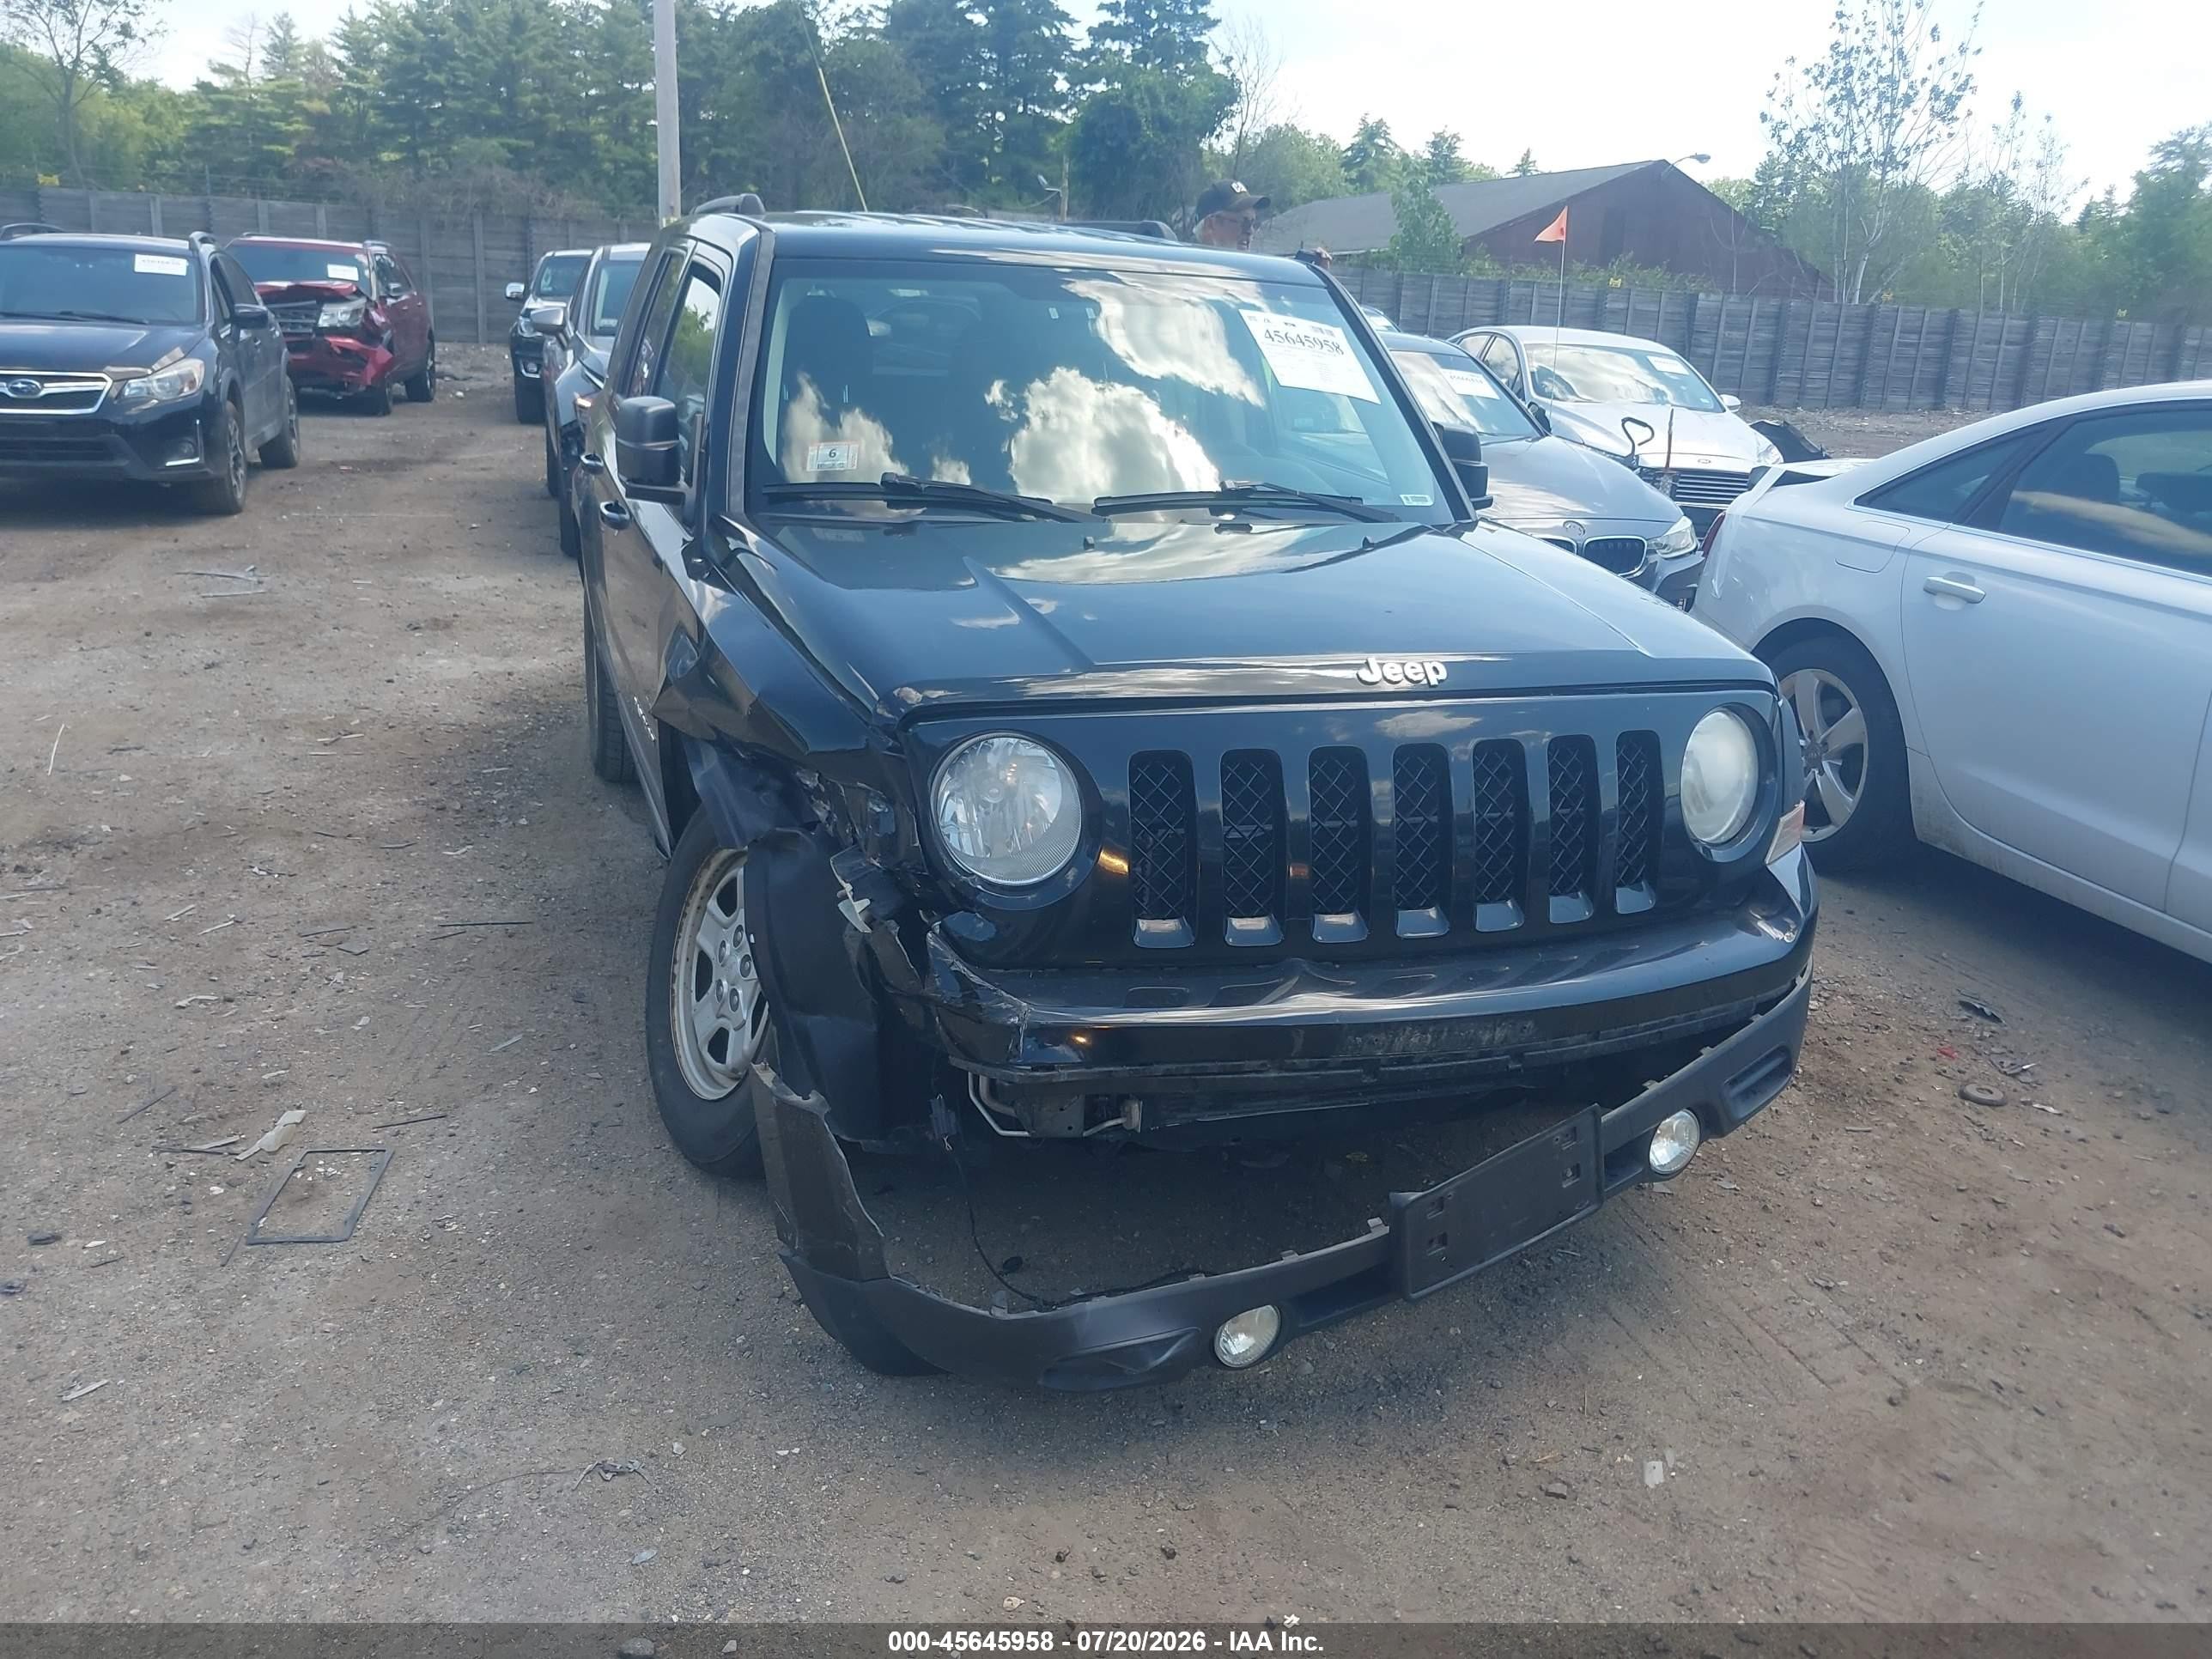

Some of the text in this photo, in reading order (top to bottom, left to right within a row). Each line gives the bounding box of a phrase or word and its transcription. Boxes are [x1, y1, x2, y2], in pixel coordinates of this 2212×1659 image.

[1264, 328, 1345, 356] 45645958
[829, 448, 837, 459] 6
[1356, 656, 1449, 688] Jeep
